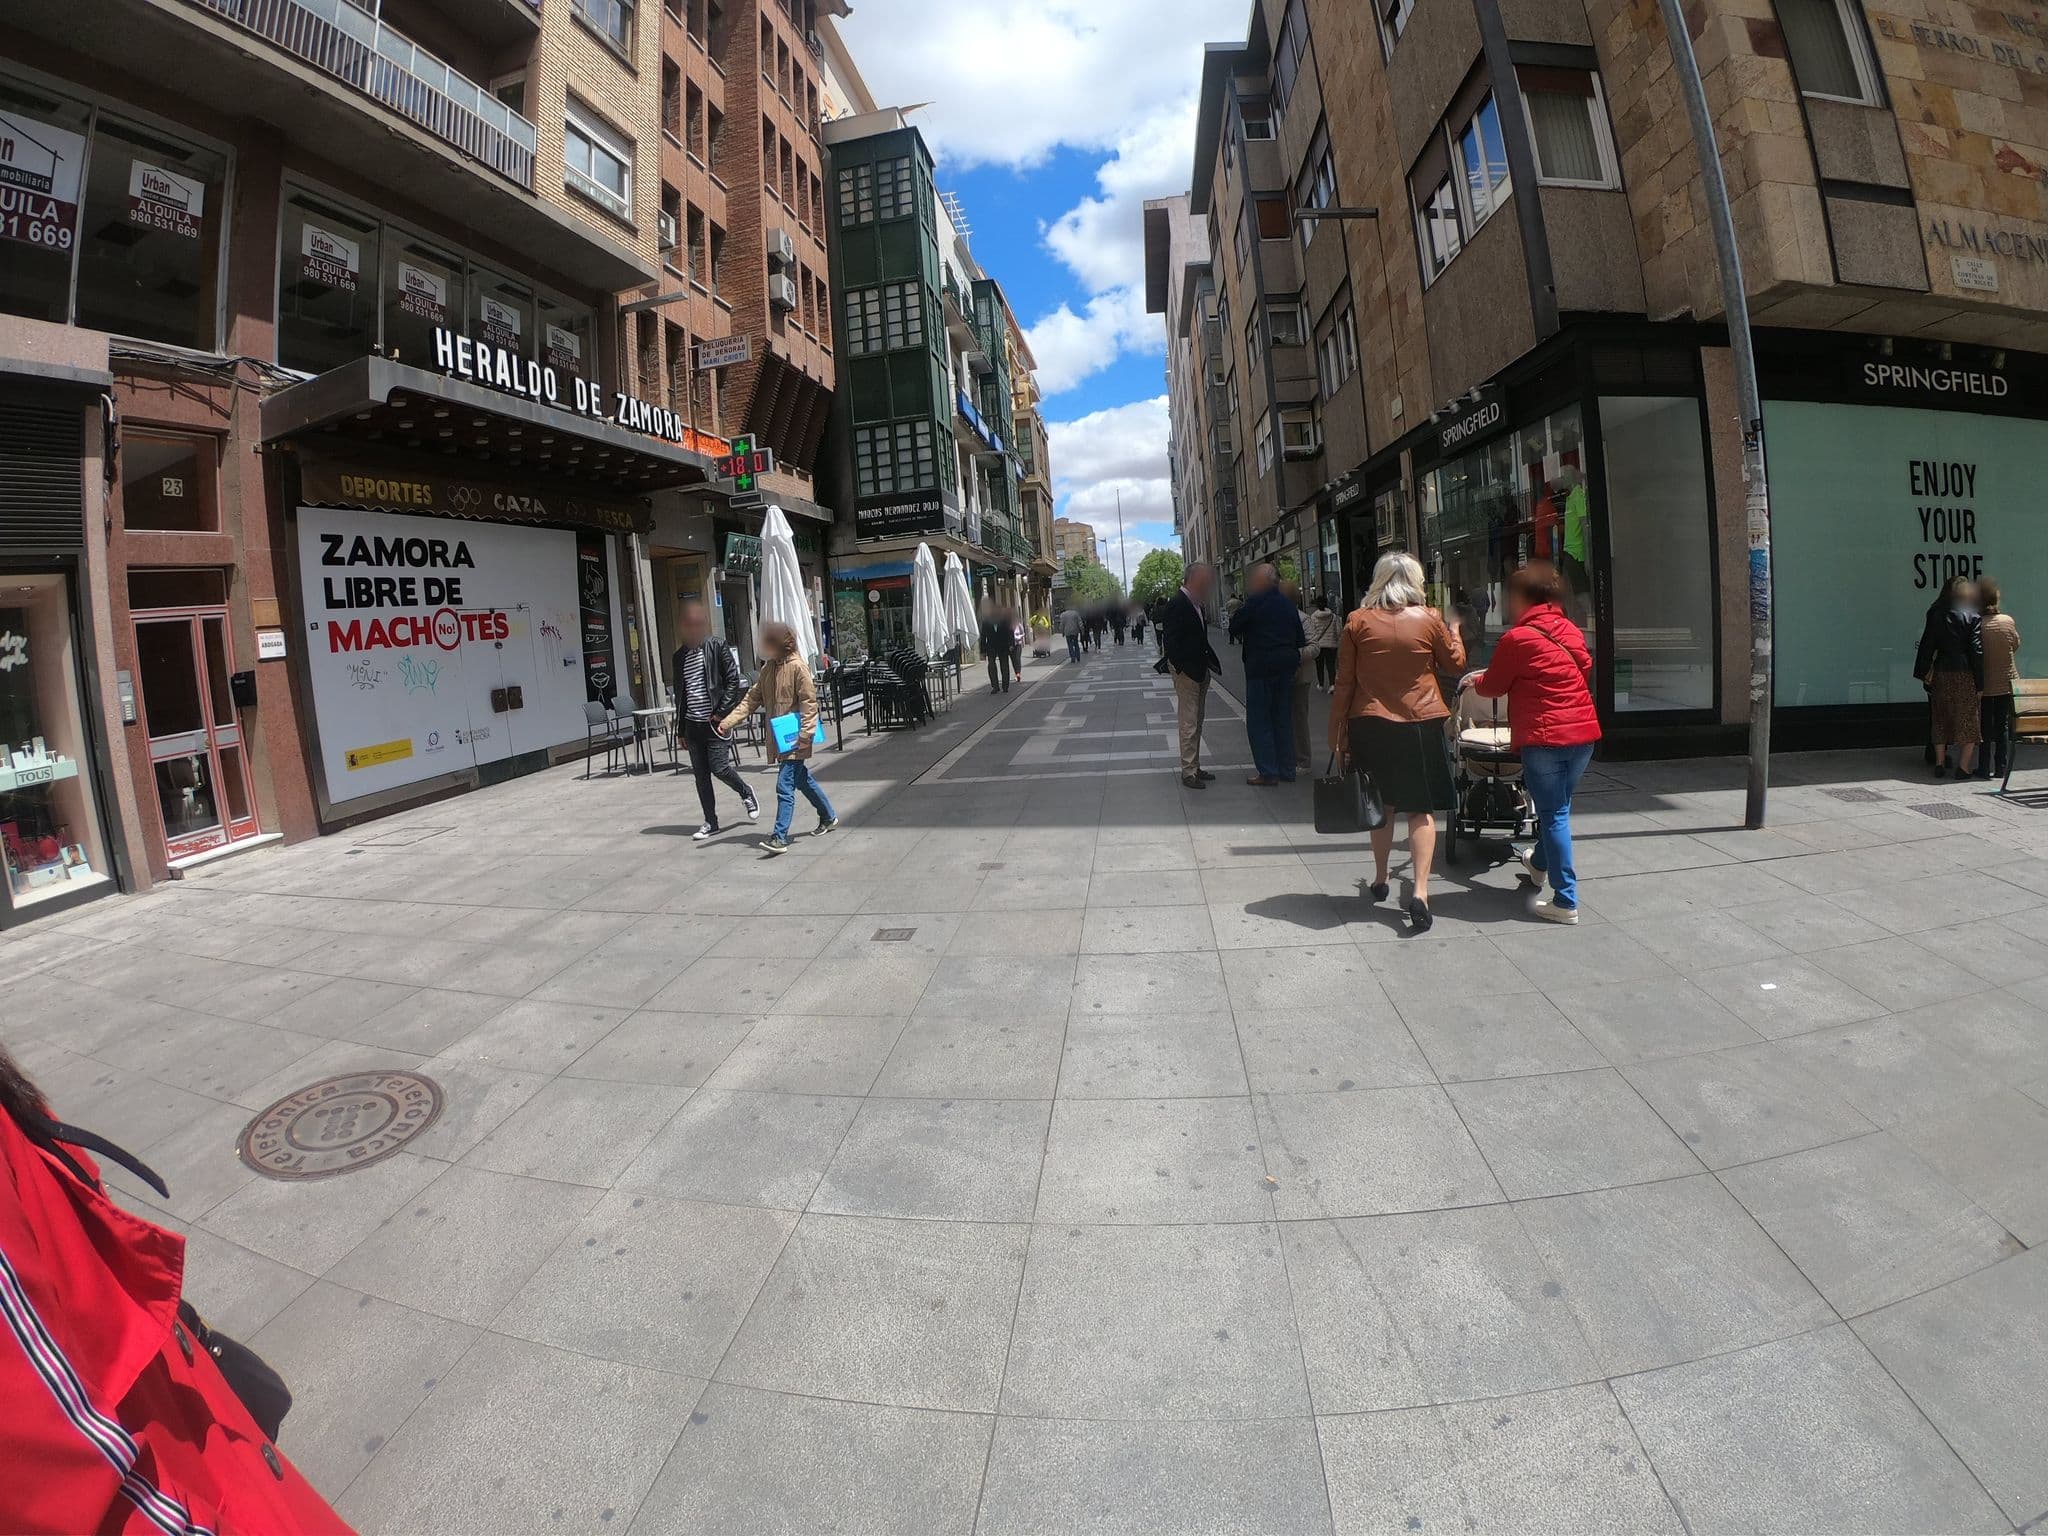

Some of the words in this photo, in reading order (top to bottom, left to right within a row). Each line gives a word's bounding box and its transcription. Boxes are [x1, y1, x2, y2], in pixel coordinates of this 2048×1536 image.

[1877, 16, 1906, 40] EL
[1908, 24, 1991, 60] FERROL
[1992, 41, 2030, 71] DEL
[142, 171, 170, 195] Urban
[0, 187, 60, 223] UILA
[137, 200, 192, 226] ALQUILA
[130, 209, 151, 225] 980
[154, 217, 174, 232] 531
[177, 223, 198, 239] 669
[311, 234, 334, 254] Urban
[1926, 219, 2048, 264] ALMACEN
[303, 265, 320, 279] 980
[322, 272, 337, 286] 531
[340, 278, 356, 291] 669
[308, 258, 351, 280] ALQUILA
[405, 271, 425, 289] Urban
[400, 300, 414, 312] 980
[415, 305, 429, 318] 531
[430, 311, 444, 323] 669
[404, 293, 440, 313] ALQUILA
[701, 351, 711, 359] DE
[434, 326, 557, 401] HERALDO
[574, 376, 603, 416] DE
[616, 392, 684, 442] ZAMORA
[1863, 362, 2008, 397] SPRINGFIELD
[1442, 402, 1500, 448] SPRINGFIELD
[164, 479, 182, 496] 23
[1909, 460, 1977, 498] ENJOY
[340, 474, 433, 506] DEPORTES
[494, 492, 548, 515] CAZA
[1917, 507, 1977, 543] YOUR
[320, 533, 476, 569] ZAMORA
[323, 576, 419, 609] LIBRE
[423, 577, 464, 606] DE
[19, 769, 51, 784] TOUS
